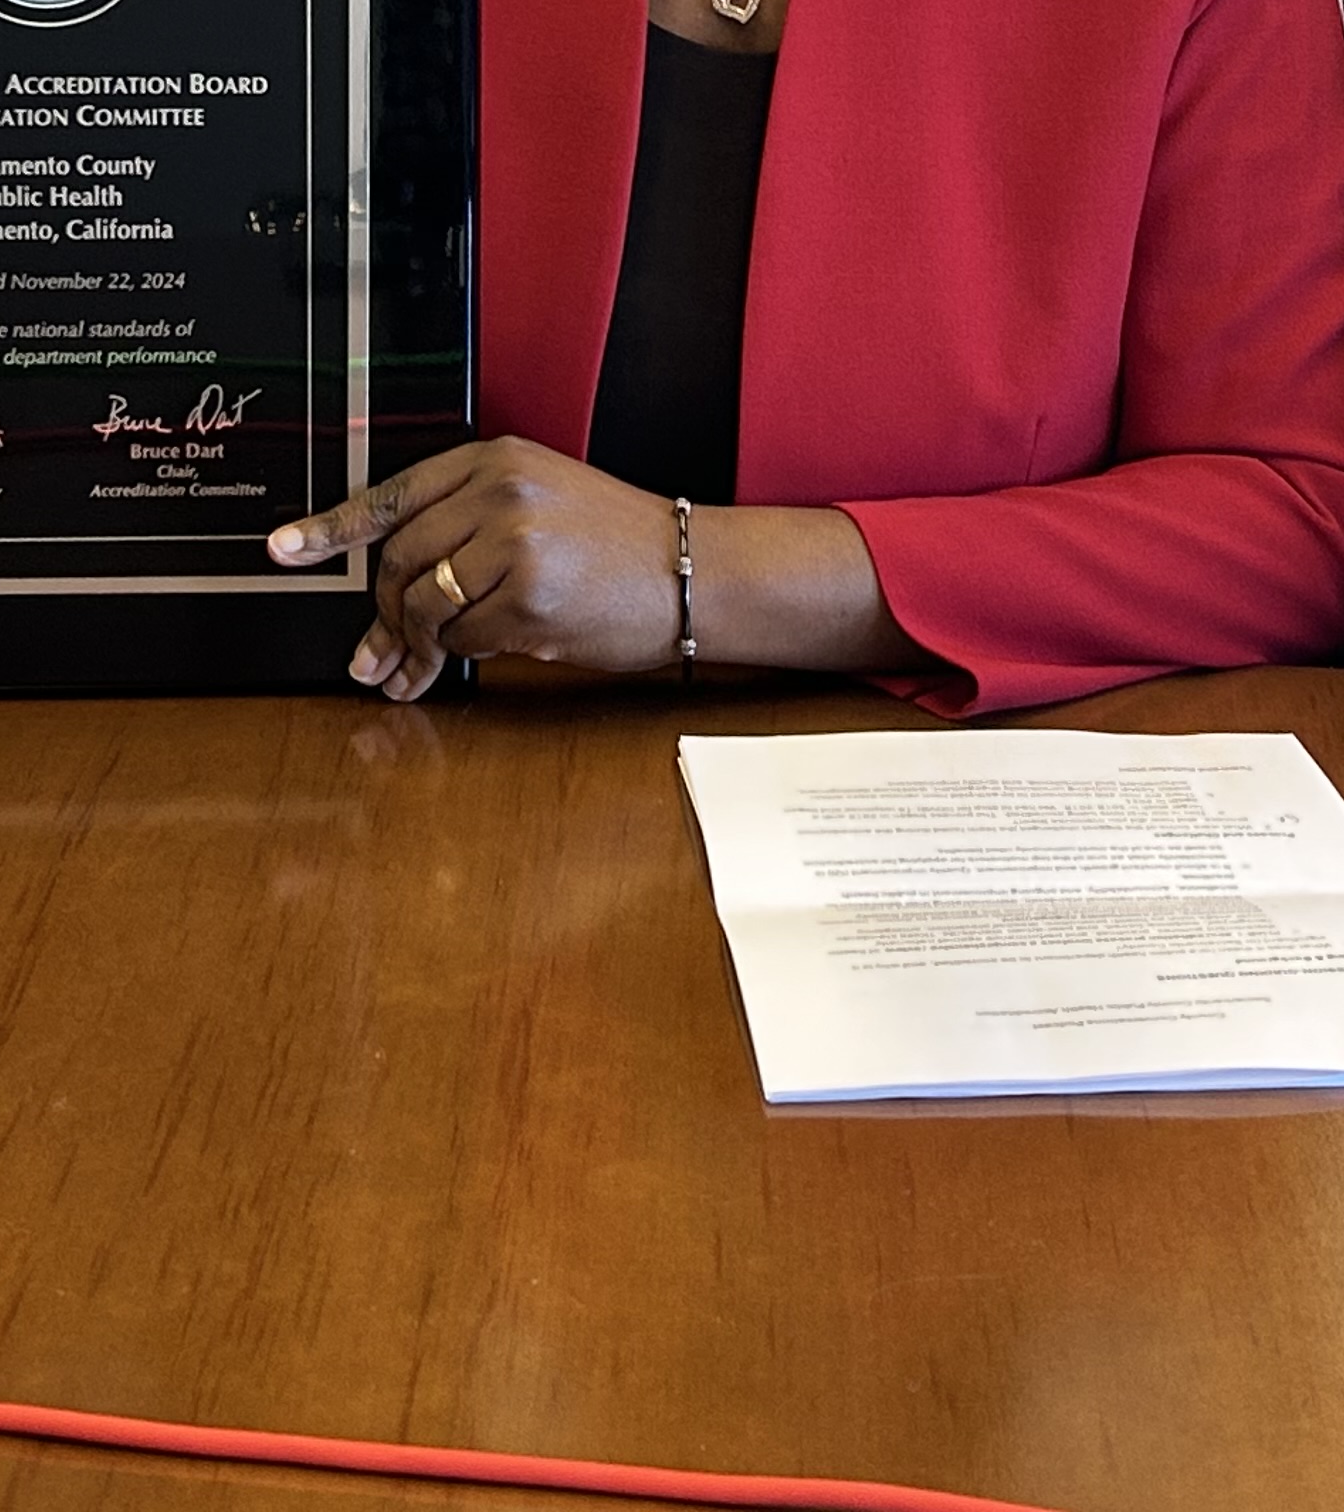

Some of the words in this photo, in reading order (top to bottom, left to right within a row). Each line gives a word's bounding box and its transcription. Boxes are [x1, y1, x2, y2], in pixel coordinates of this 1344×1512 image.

[4, 73, 182, 95] ACCREDITATION
[189, 72, 268, 95] BOARD
[75, 105, 205, 127] COMMITTEE
[75, 154, 156, 181] County
[49, 184, 123, 207] Health
[65, 218, 174, 241] California
[10, 272, 103, 290] November
[107, 272, 135, 292] 22,
[140, 272, 186, 289] 2024
[12, 319, 85, 338] national
[88, 319, 171, 338] standards
[174, 318, 196, 337] of
[2, 347, 103, 369] department
[106, 346, 217, 368] performance
[130, 443, 181, 460] Bruce
[185, 442, 224, 459] Dart
[156, 464, 200, 480] Chair,
[89, 483, 186, 498] Accreditation
[189, 482, 267, 497] Committee
